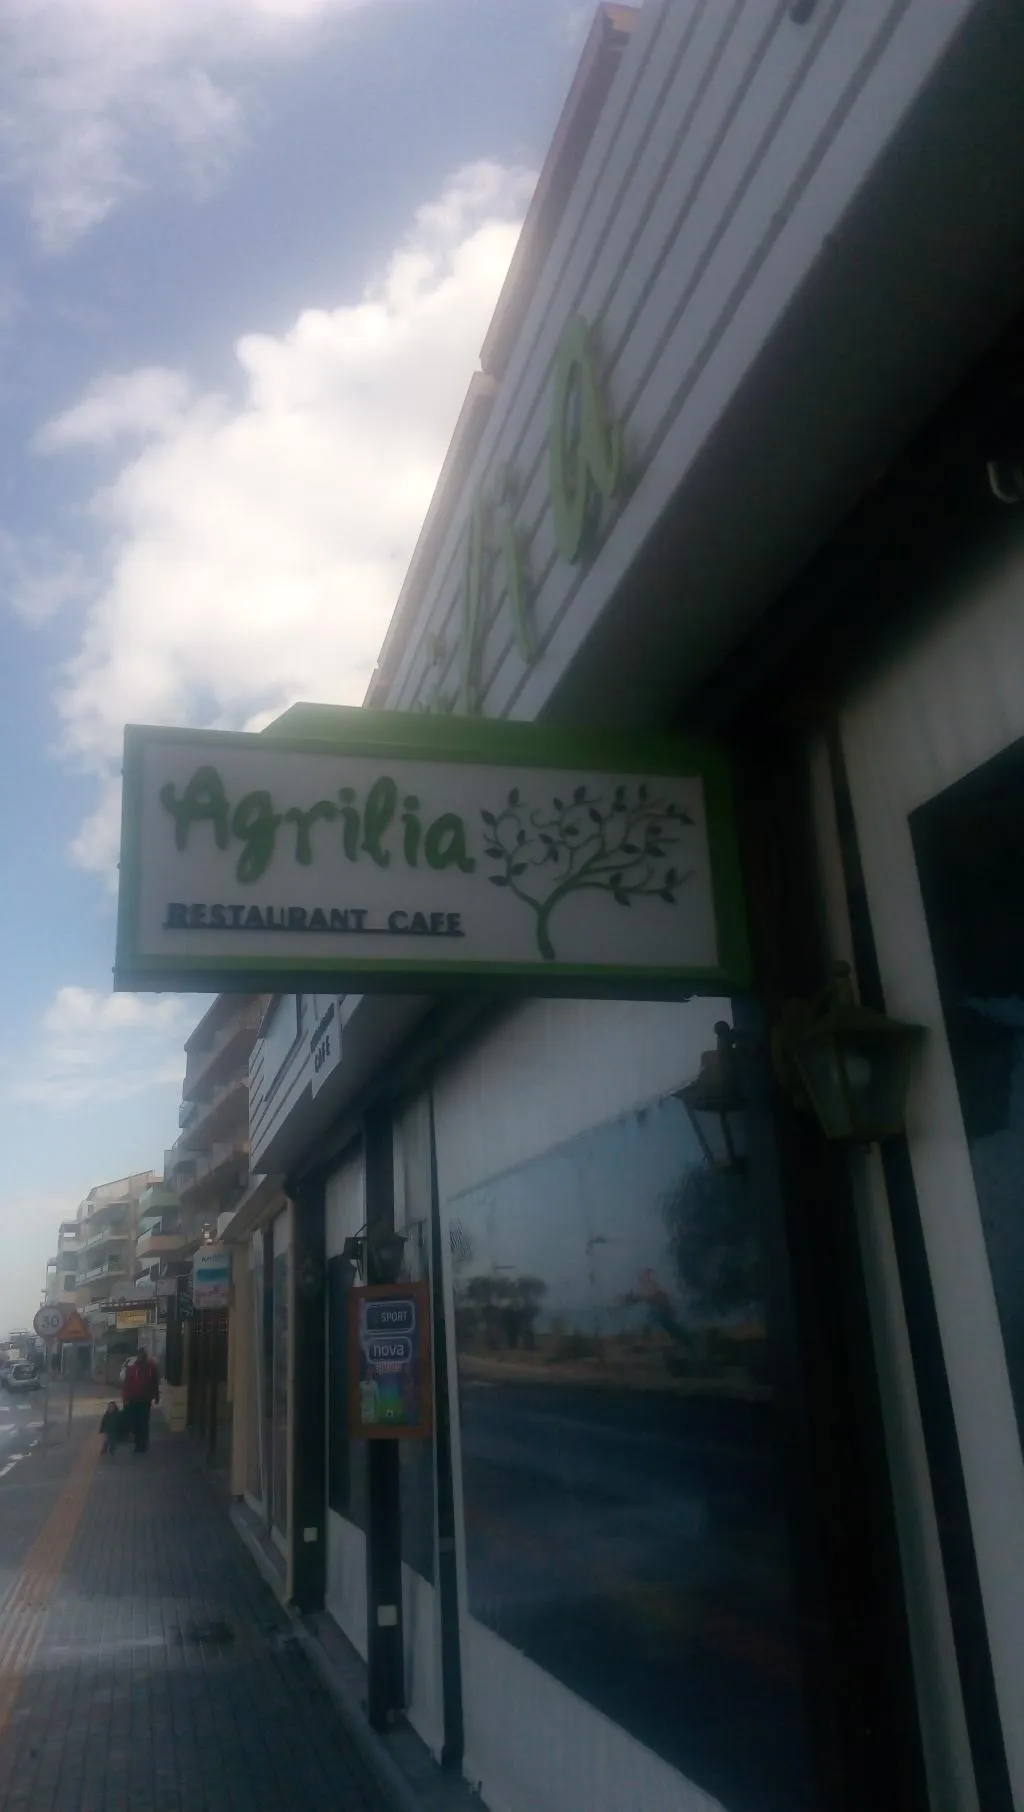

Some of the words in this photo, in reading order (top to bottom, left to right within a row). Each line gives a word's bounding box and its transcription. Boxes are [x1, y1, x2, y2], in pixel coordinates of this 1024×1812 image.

[160, 765, 477, 884] Agrilia
[166, 902, 368, 930] RESTAURANT
[388, 910, 463, 936] CAFE
[380, 1310, 408, 1322] SPORT
[373, 1342, 405, 1357] nova
